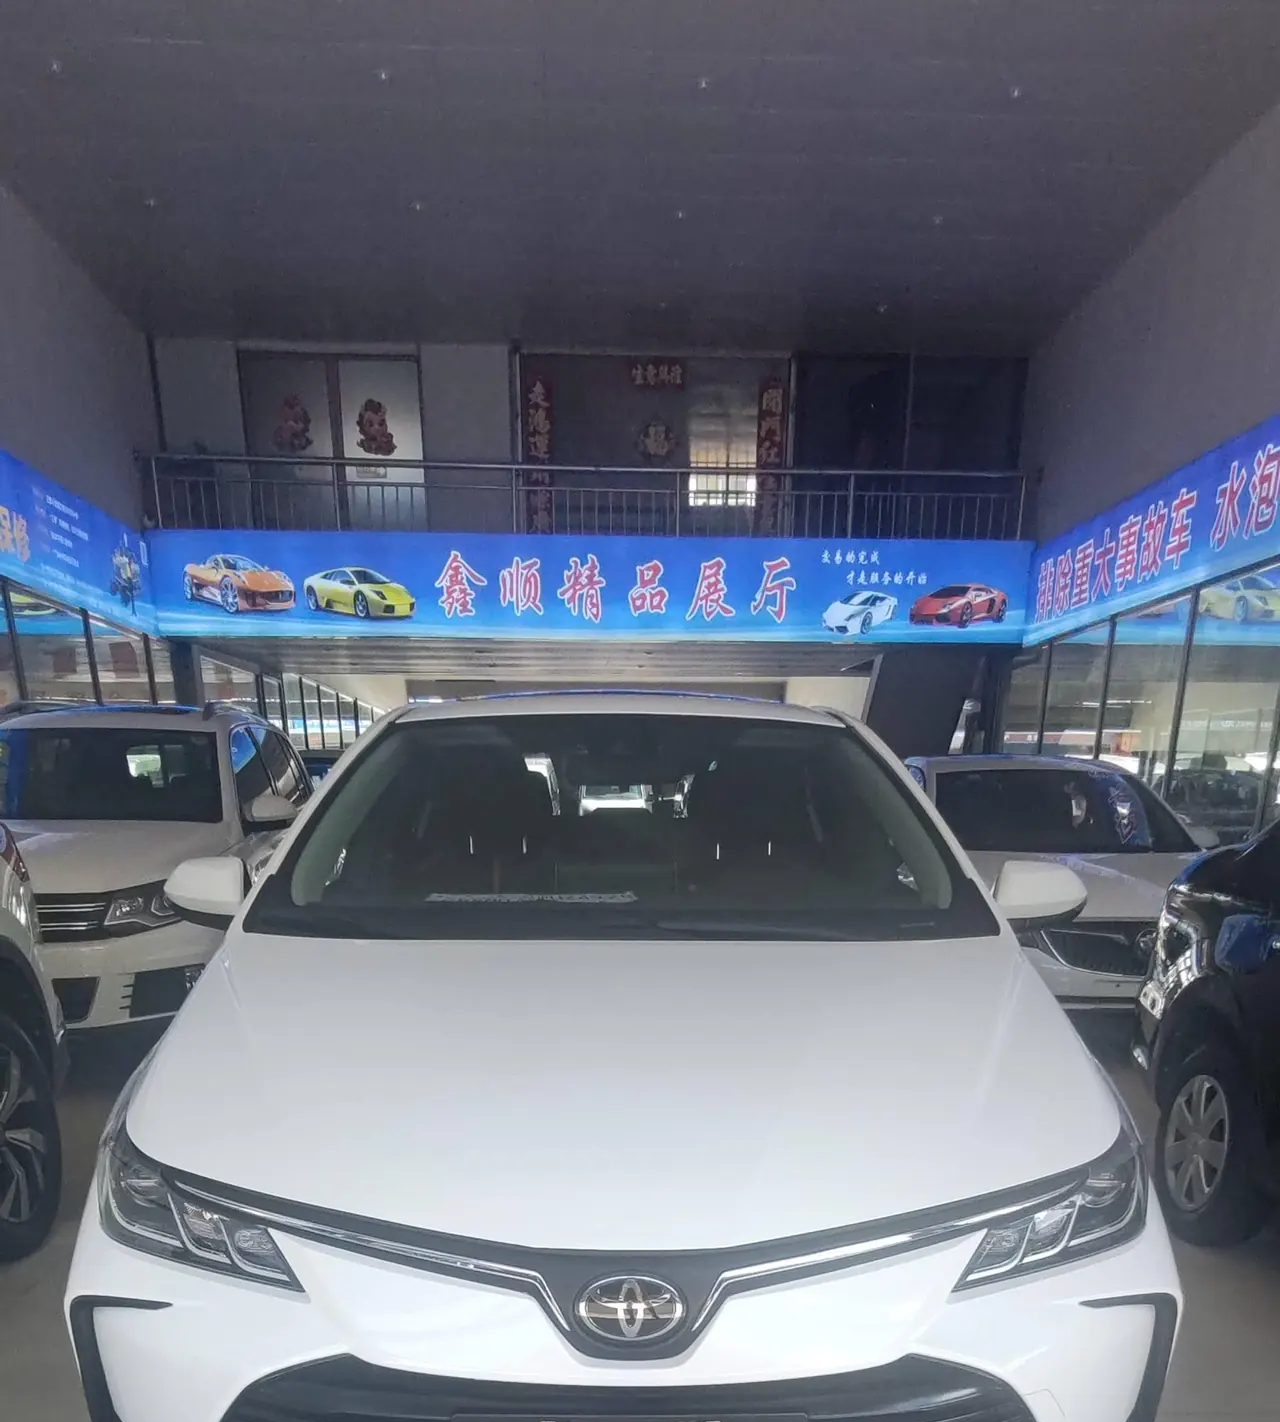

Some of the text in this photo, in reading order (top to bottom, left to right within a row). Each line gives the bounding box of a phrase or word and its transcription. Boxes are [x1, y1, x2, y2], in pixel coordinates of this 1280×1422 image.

[821, 549, 880, 565] 交易的完成
[846, 570, 928, 586] 才是服务的开始
[1035, 488, 1197, 624] 排除重大事故车
[435, 550, 797, 623] 鑫顺精品展厅
